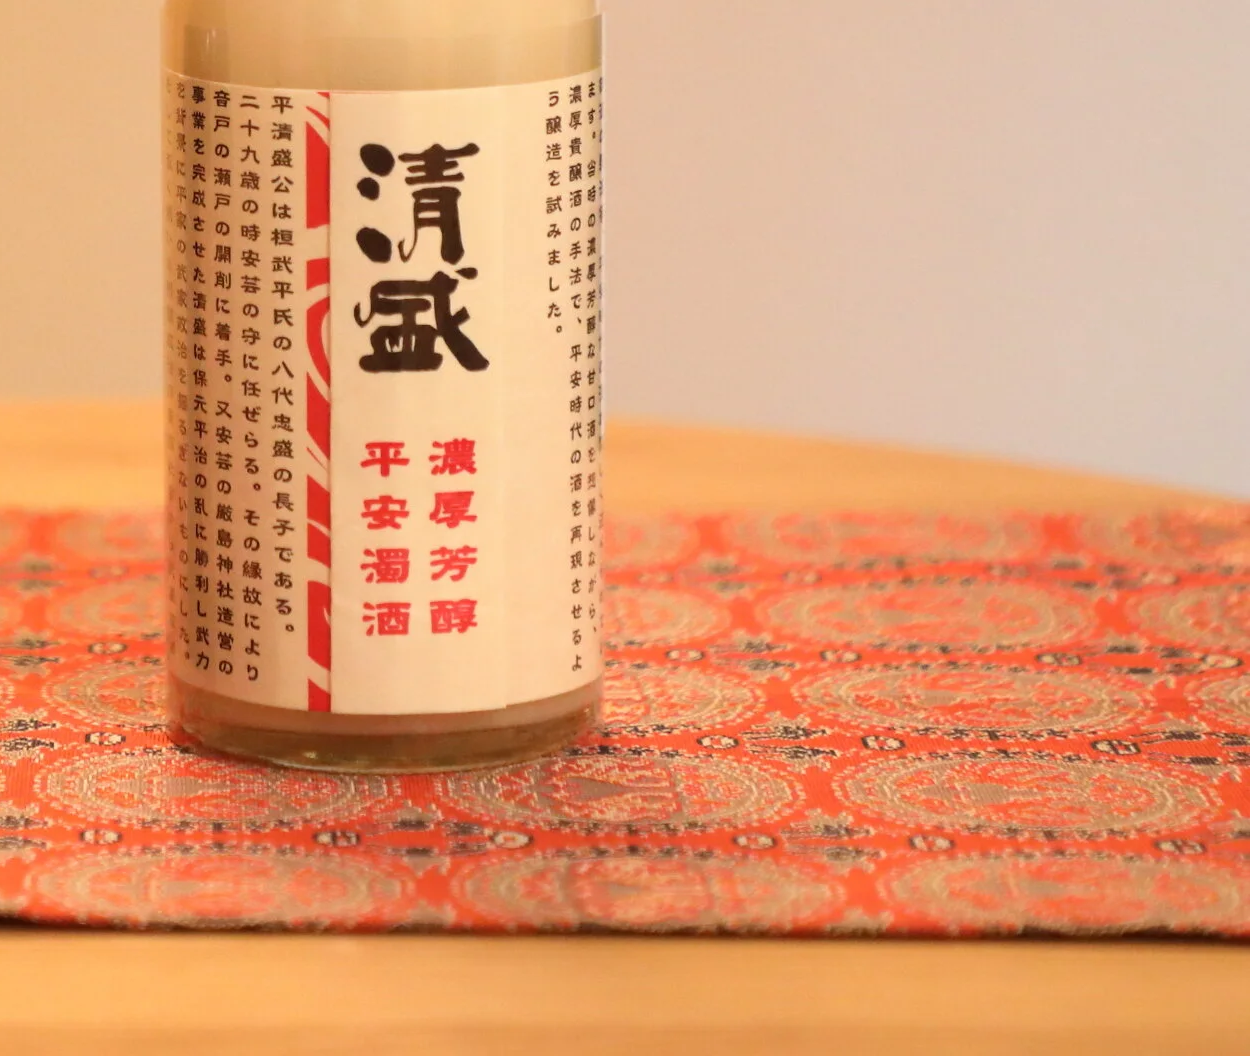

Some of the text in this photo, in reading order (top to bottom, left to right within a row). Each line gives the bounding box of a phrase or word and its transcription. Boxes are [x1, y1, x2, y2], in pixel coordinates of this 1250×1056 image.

[191, 86, 209, 670] 事業を完成させた清盛は保元平治の乱に勝利し武力
[213, 90, 234, 675] 音戸の瀬戸の開削に着手。又安芸の厳島神社造営の
[239, 95, 263, 682] 二十九歳の時安芸の守に任ぜらる。その縁故により
[271, 95, 295, 633] 平清盛公は桓武平氏の八代忠盛の長子である。
[353, 142, 490, 373] 清盛
[545, 90, 563, 333] う醸造を試みました。
[568, 84, 583, 672] 濃厚貴醸酒の手法で、平安時代の酒を再現させるよ
[360, 441, 411, 637] 平安濁酒
[428, 439, 478, 635] 濃厚芳醇
